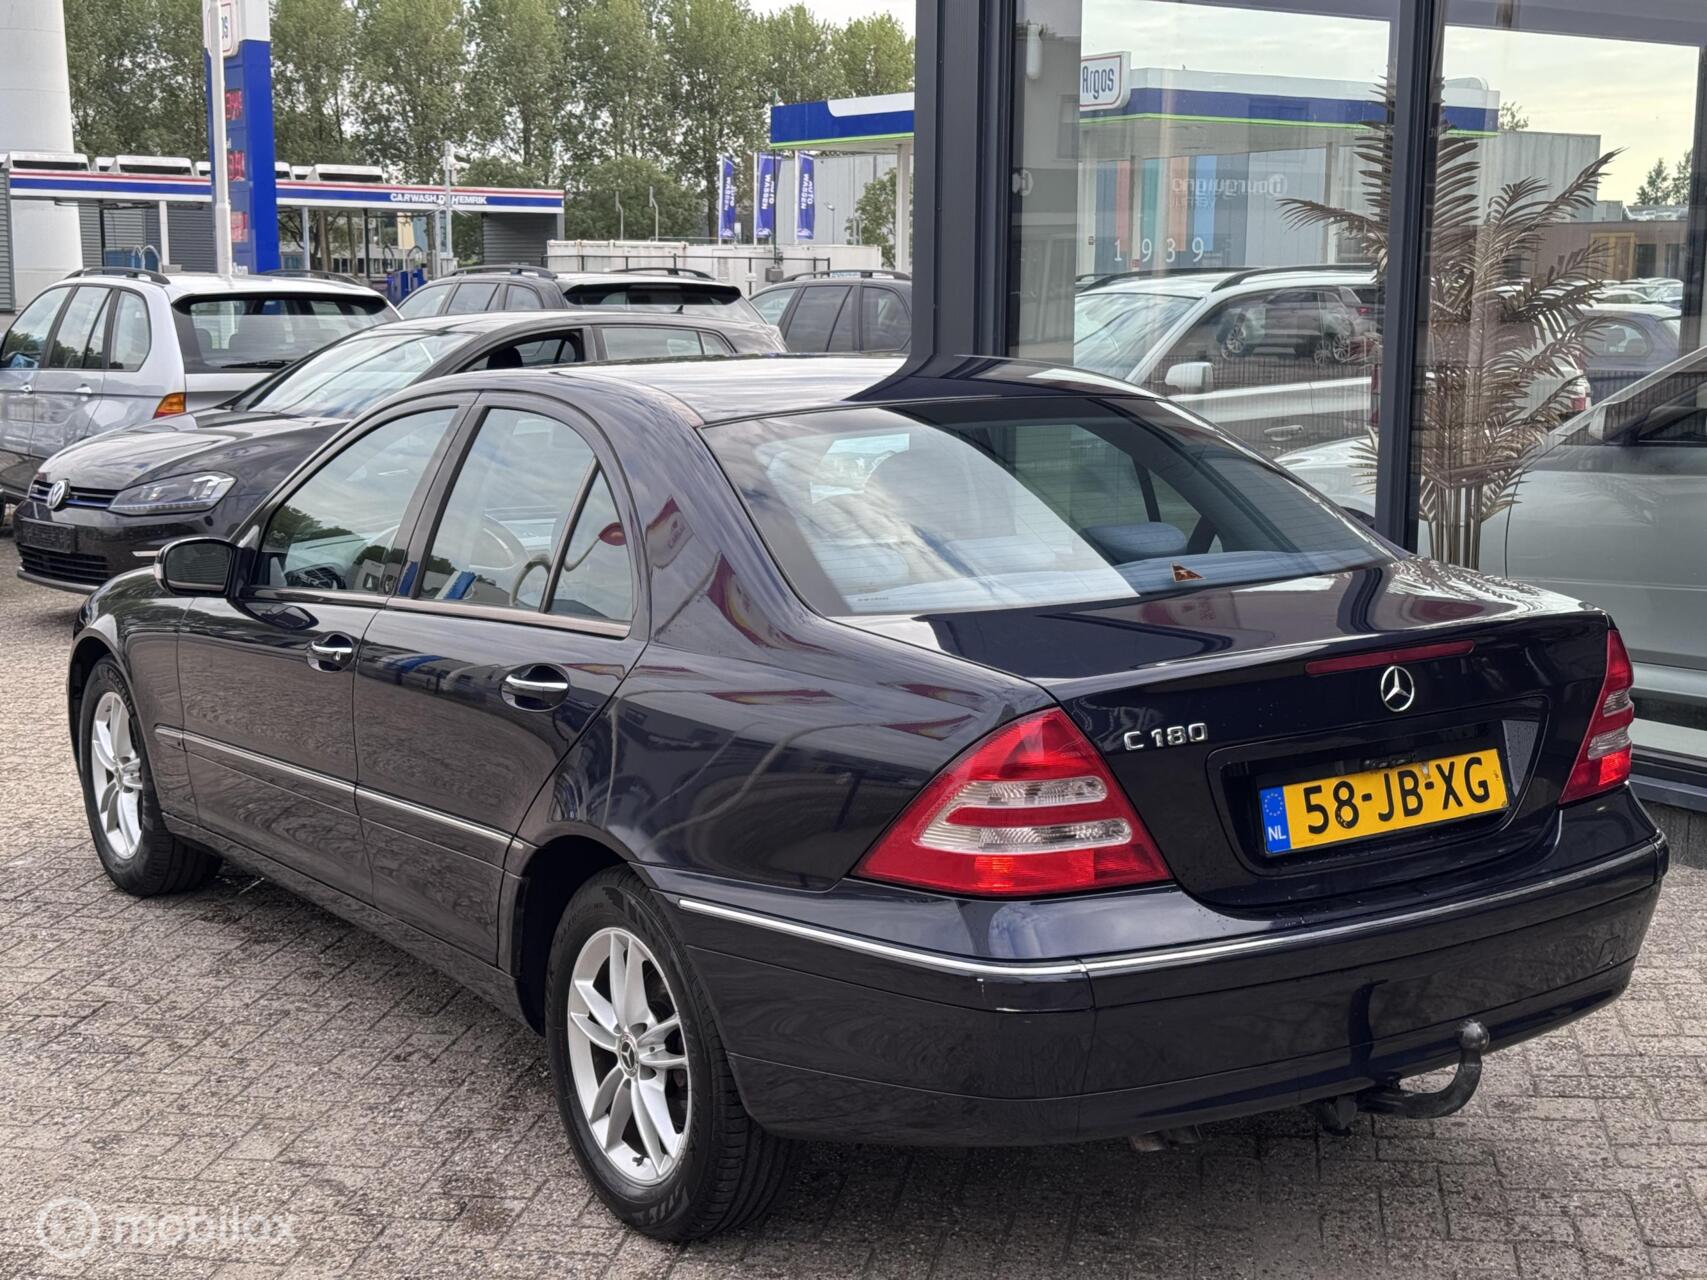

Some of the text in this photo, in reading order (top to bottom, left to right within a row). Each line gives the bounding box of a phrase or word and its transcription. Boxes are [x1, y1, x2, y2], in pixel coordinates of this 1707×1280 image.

[1082, 65, 1115, 100] Argos
[390, 193, 436, 203] CARWASH
[451, 195, 487, 205] HEMRIK
[801, 174, 809, 210] WASSEN
[1123, 722, 1209, 751] C 180
[1303, 756, 1490, 834] 58-JB-XG
[1268, 824, 1288, 842] NL
